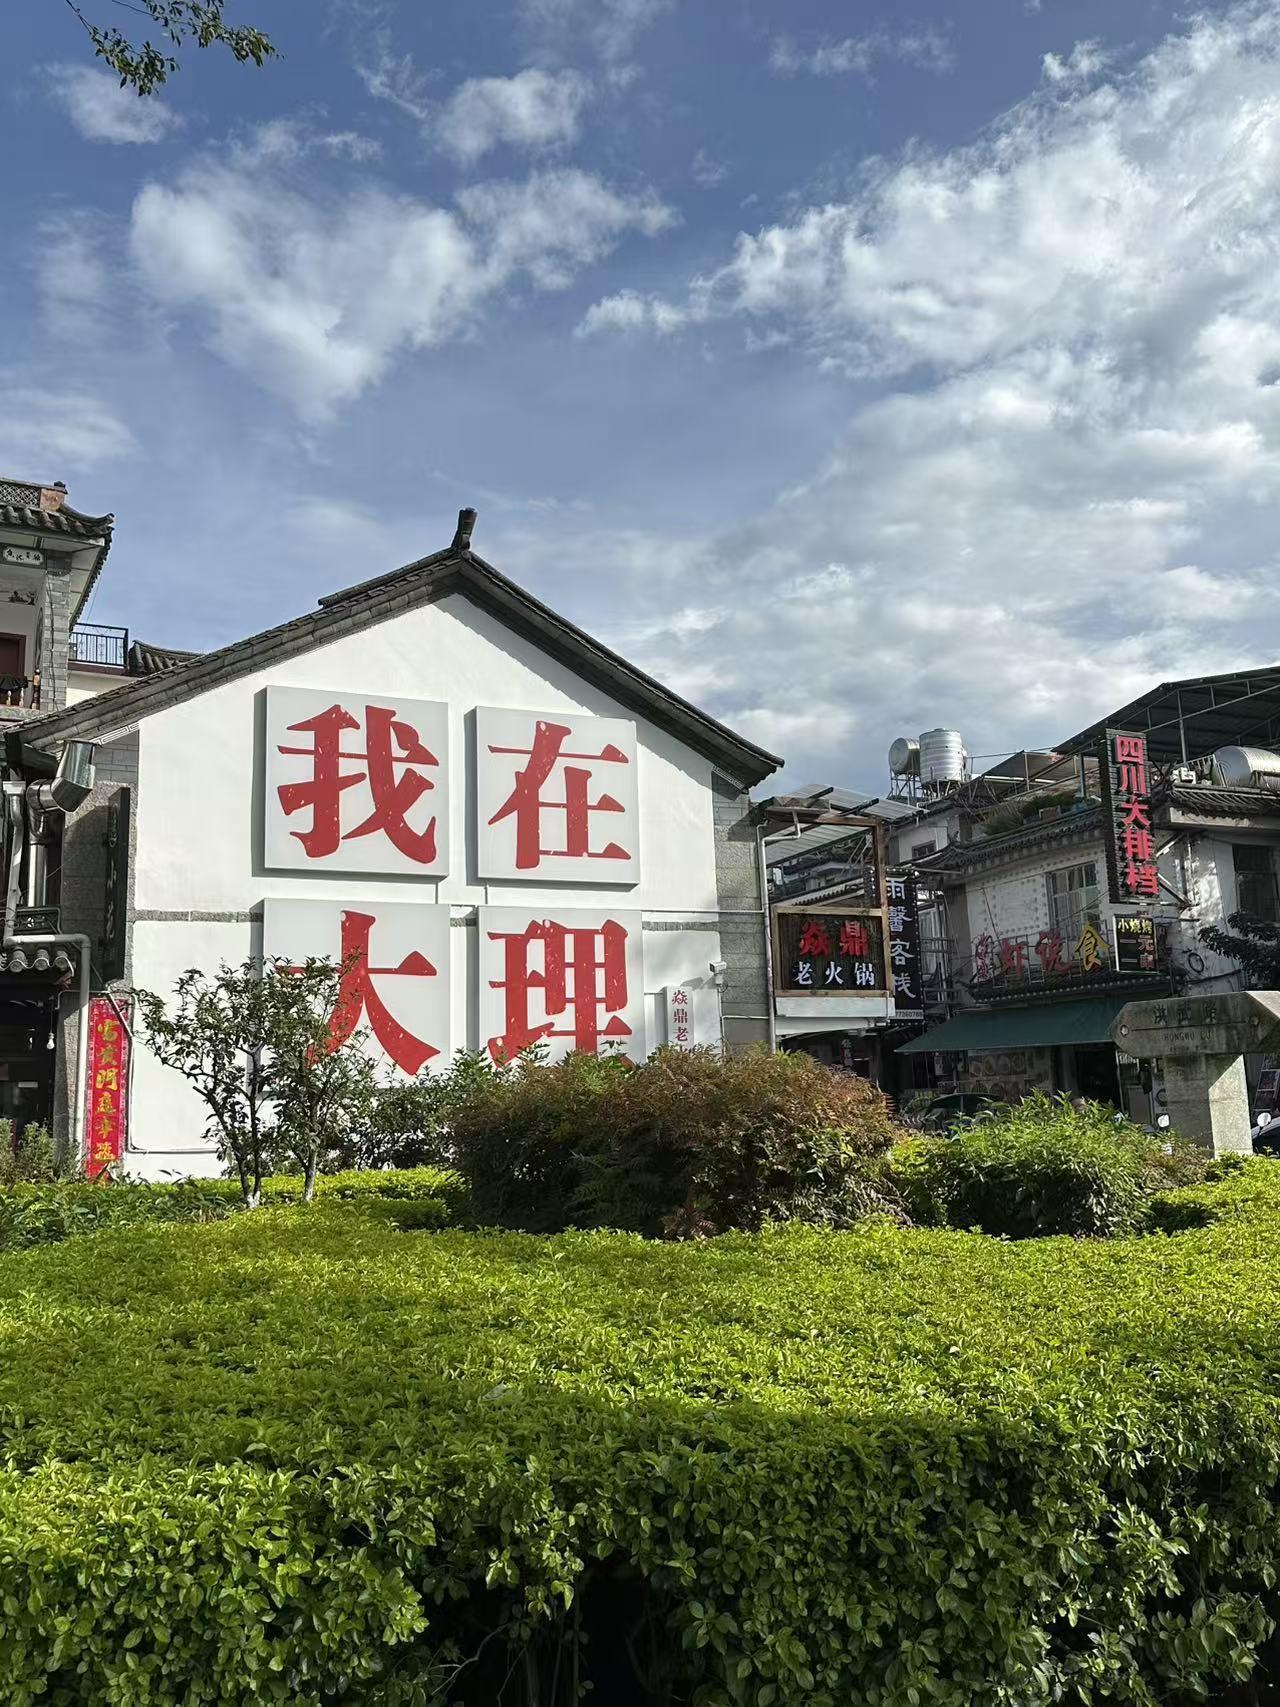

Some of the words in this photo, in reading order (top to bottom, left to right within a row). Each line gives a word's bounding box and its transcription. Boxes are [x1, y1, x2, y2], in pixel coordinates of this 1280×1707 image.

[276, 704, 631, 870] 我在
[1114, 735, 1159, 896] 四川大排档
[275, 910, 632, 1076] 大理
[793, 961, 876, 987] 老火锅
[799, 920, 870, 957] 焱鼎
[671, 989, 689, 1053] 焱鼎老
